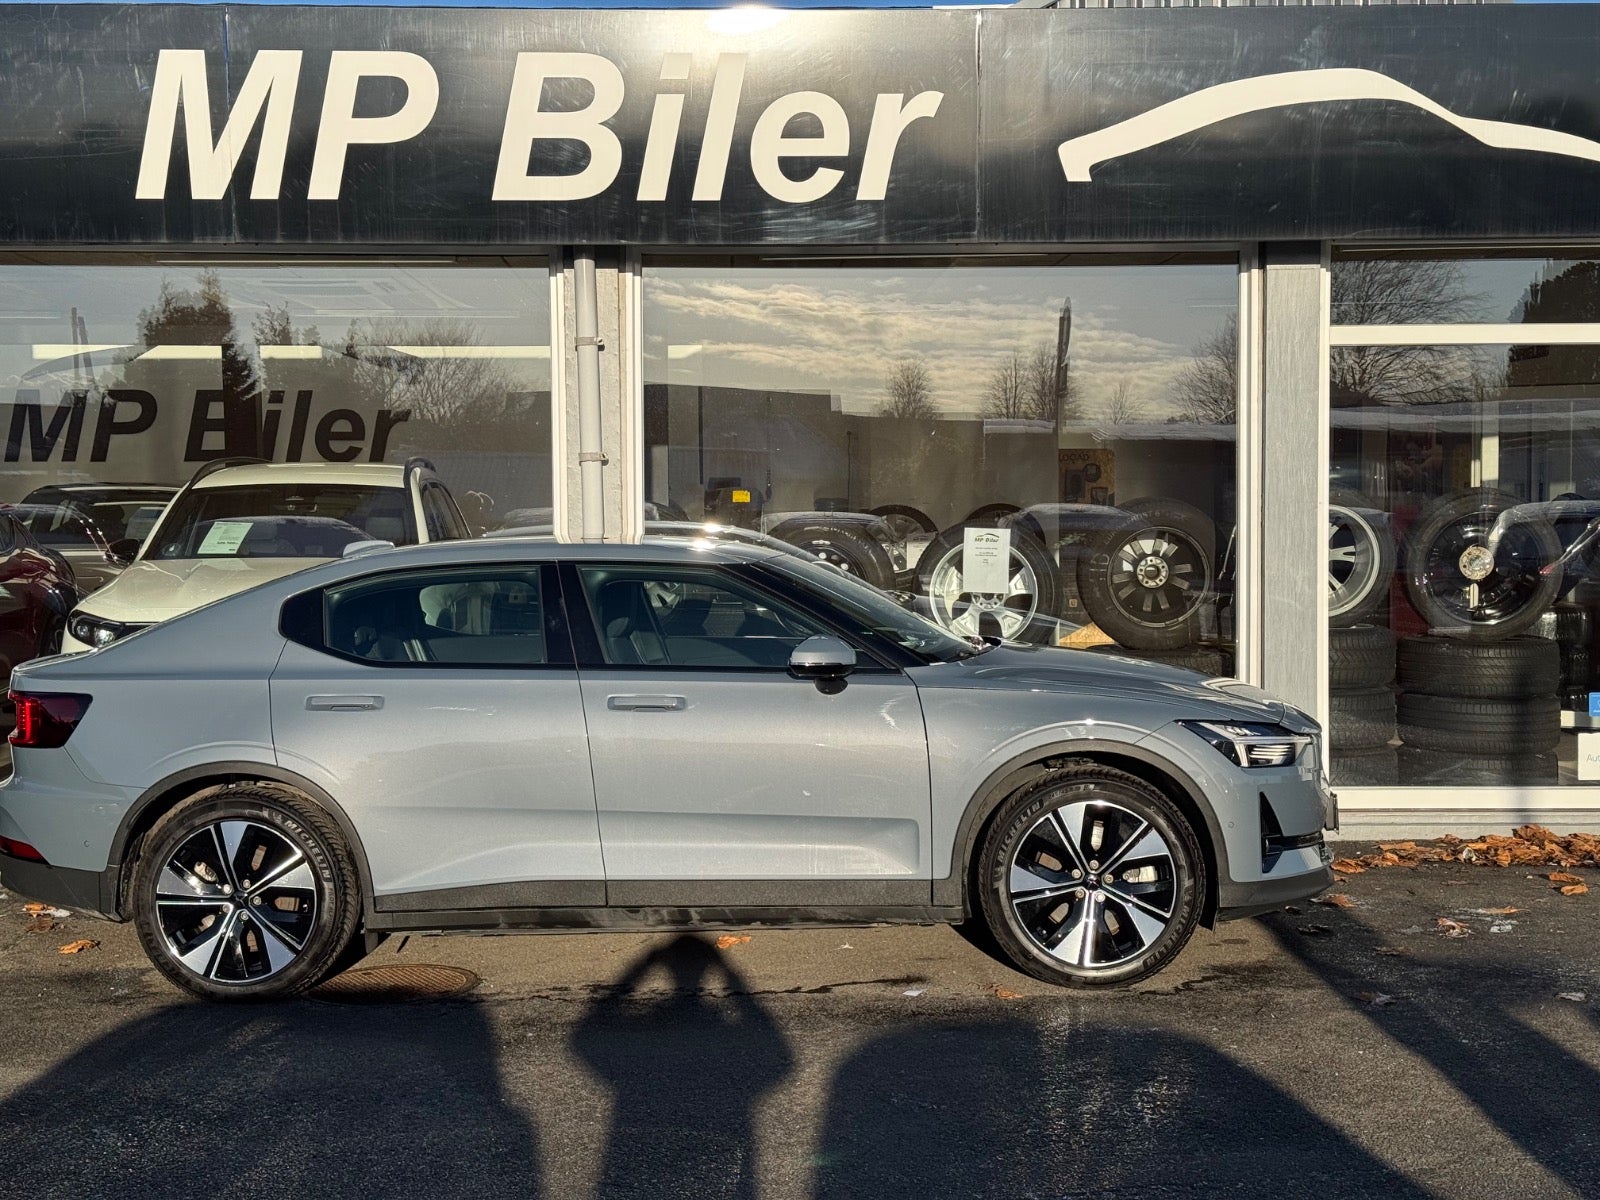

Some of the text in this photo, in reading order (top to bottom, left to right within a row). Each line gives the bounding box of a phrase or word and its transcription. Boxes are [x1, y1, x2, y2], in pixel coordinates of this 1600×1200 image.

[135, 49, 943, 203] MP Biler
[4, 389, 158, 463] MP
[284, 820, 331, 879] MICHELIN
[997, 801, 1041, 863] MICHELIN
[1146, 904, 1190, 967] MICHELIN
